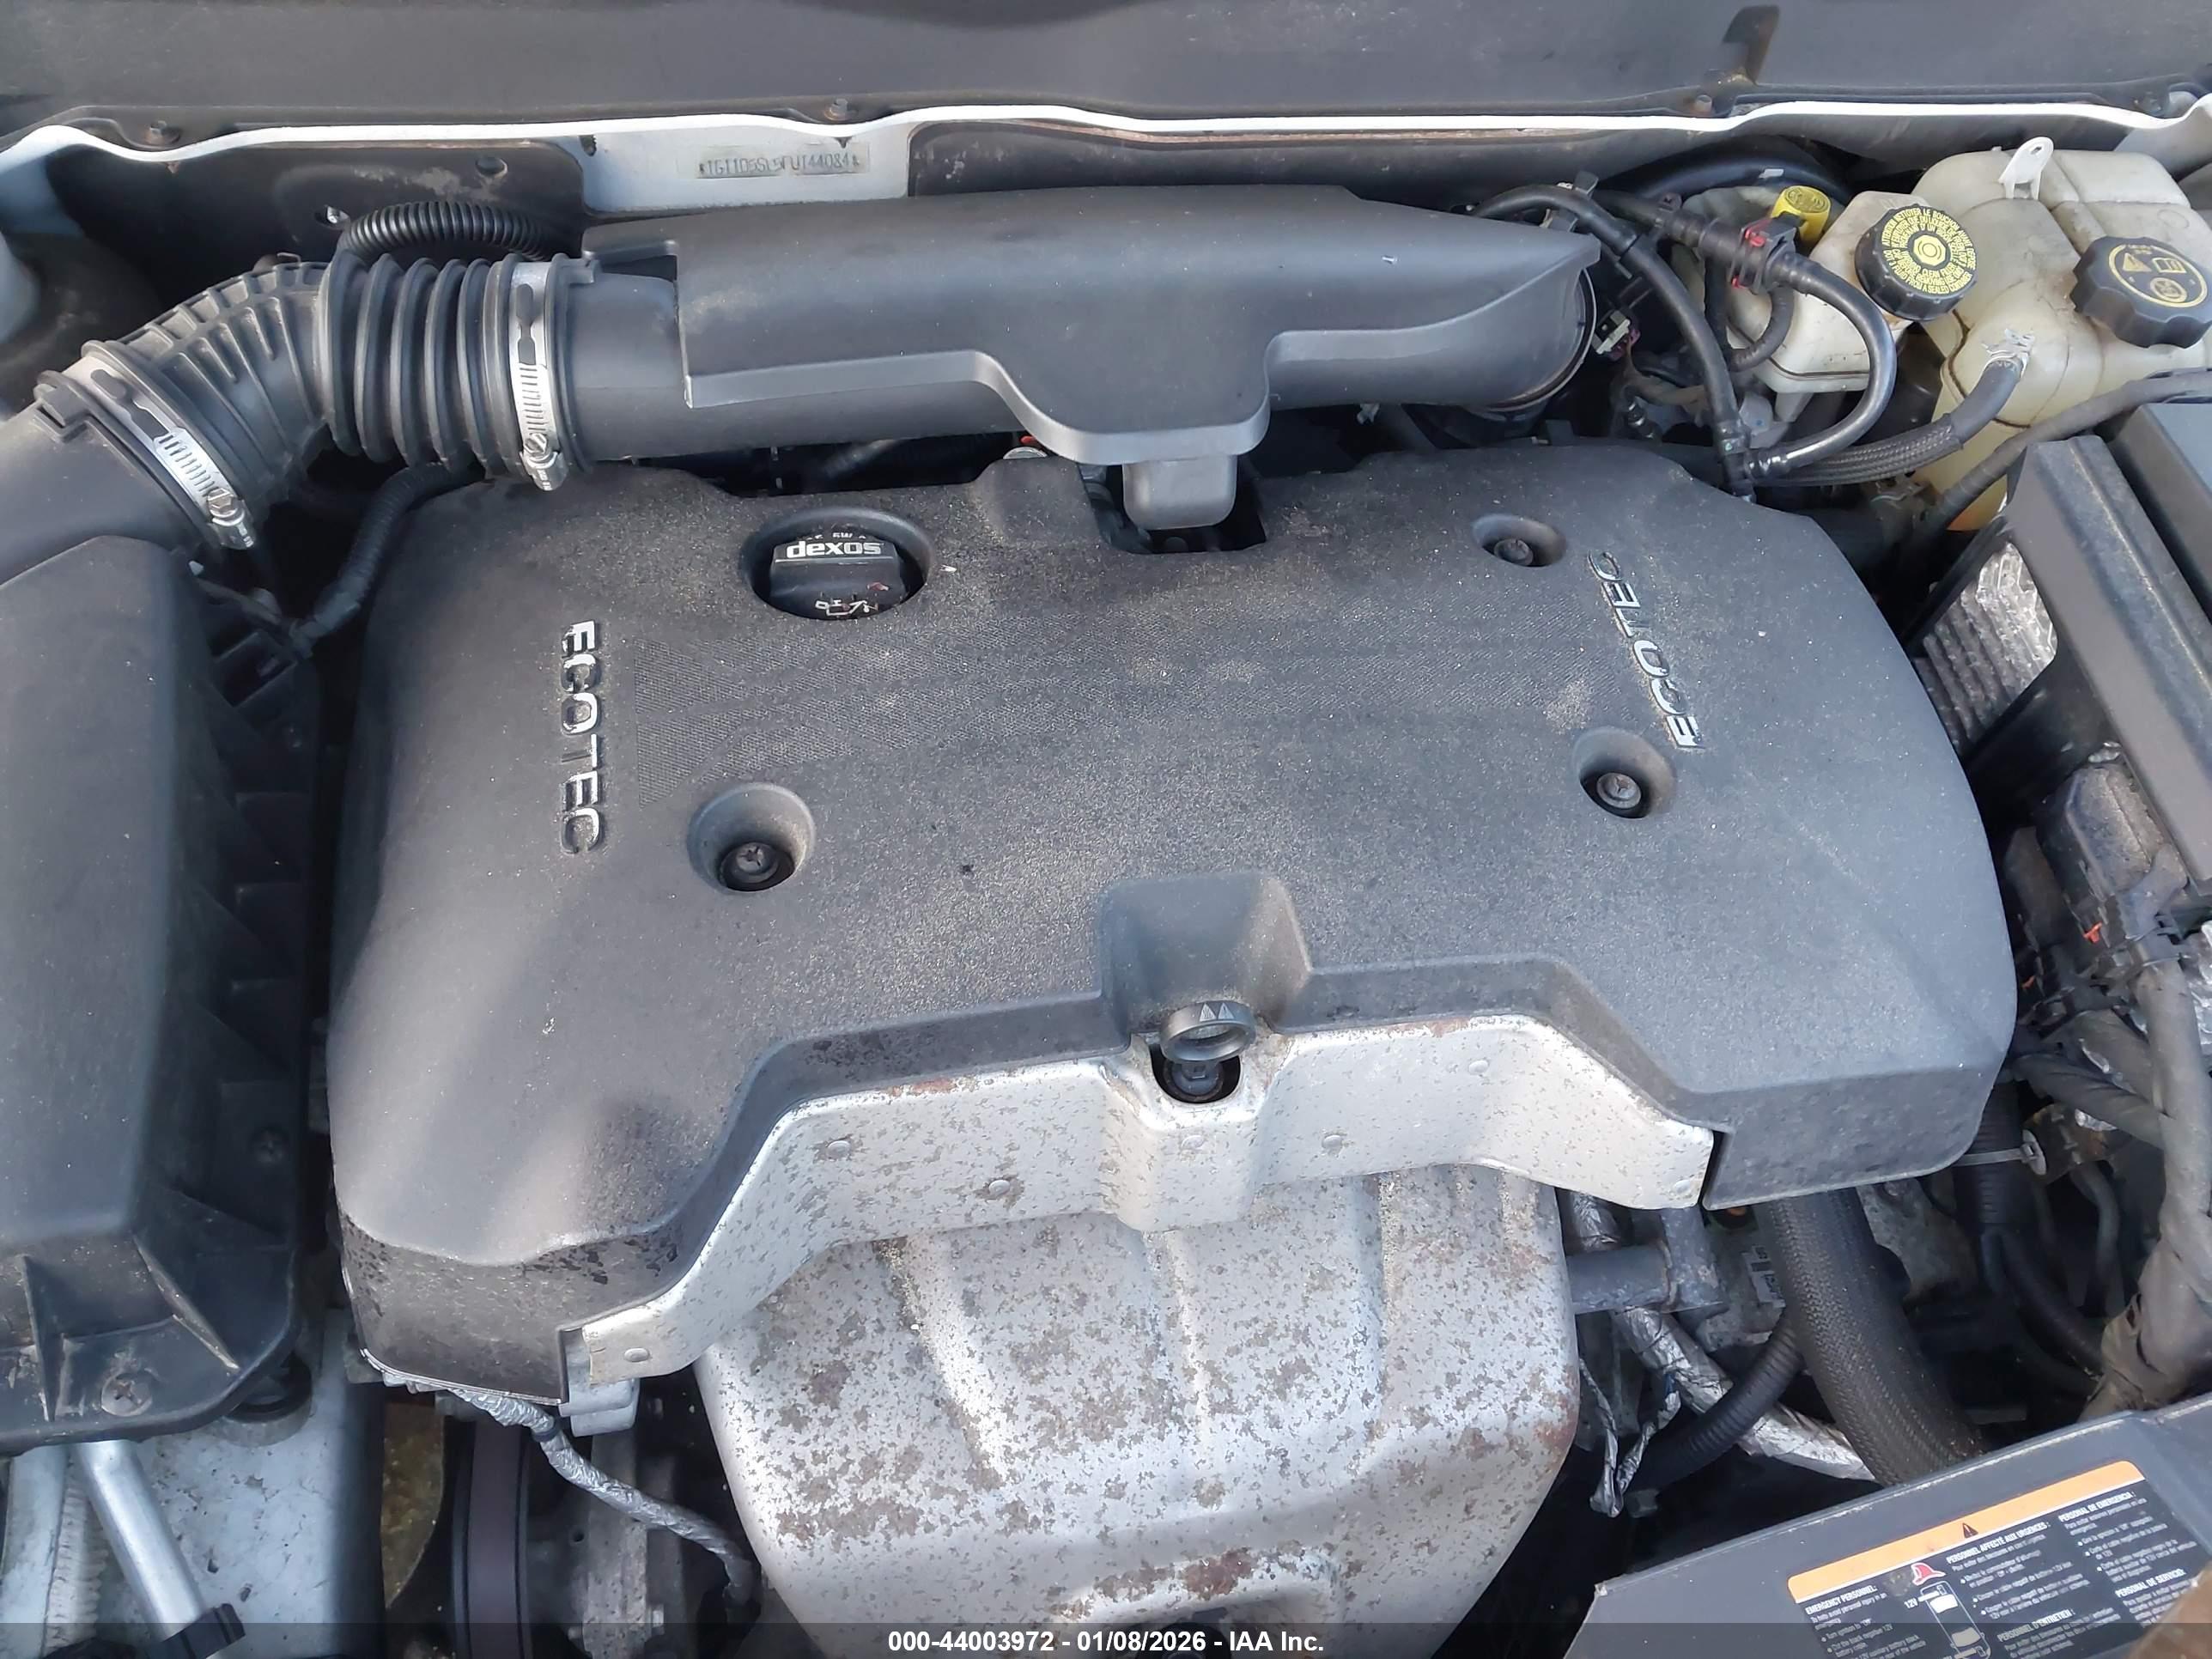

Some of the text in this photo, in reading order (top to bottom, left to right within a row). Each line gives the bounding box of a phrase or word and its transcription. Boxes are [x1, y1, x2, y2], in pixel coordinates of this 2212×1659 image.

[1923, 208, 1929, 216] LE
[1933, 210, 1960, 231] BOUCHON
[1957, 229, 1973, 247] AVANT
[1883, 251, 1893, 260] DOT
[1905, 276, 1922, 289] FROM
[1928, 285, 1949, 294] SEALED
[1922, 269, 1941, 277] CLEAN
[787, 541, 881, 559] dexos
[1588, 550, 1705, 750] ECOTEC
[561, 620, 600, 854] ECOTEC
[1805, 1597, 1841, 1614] EMERGENCY
[1904, 1597, 1918, 1608] 12V
